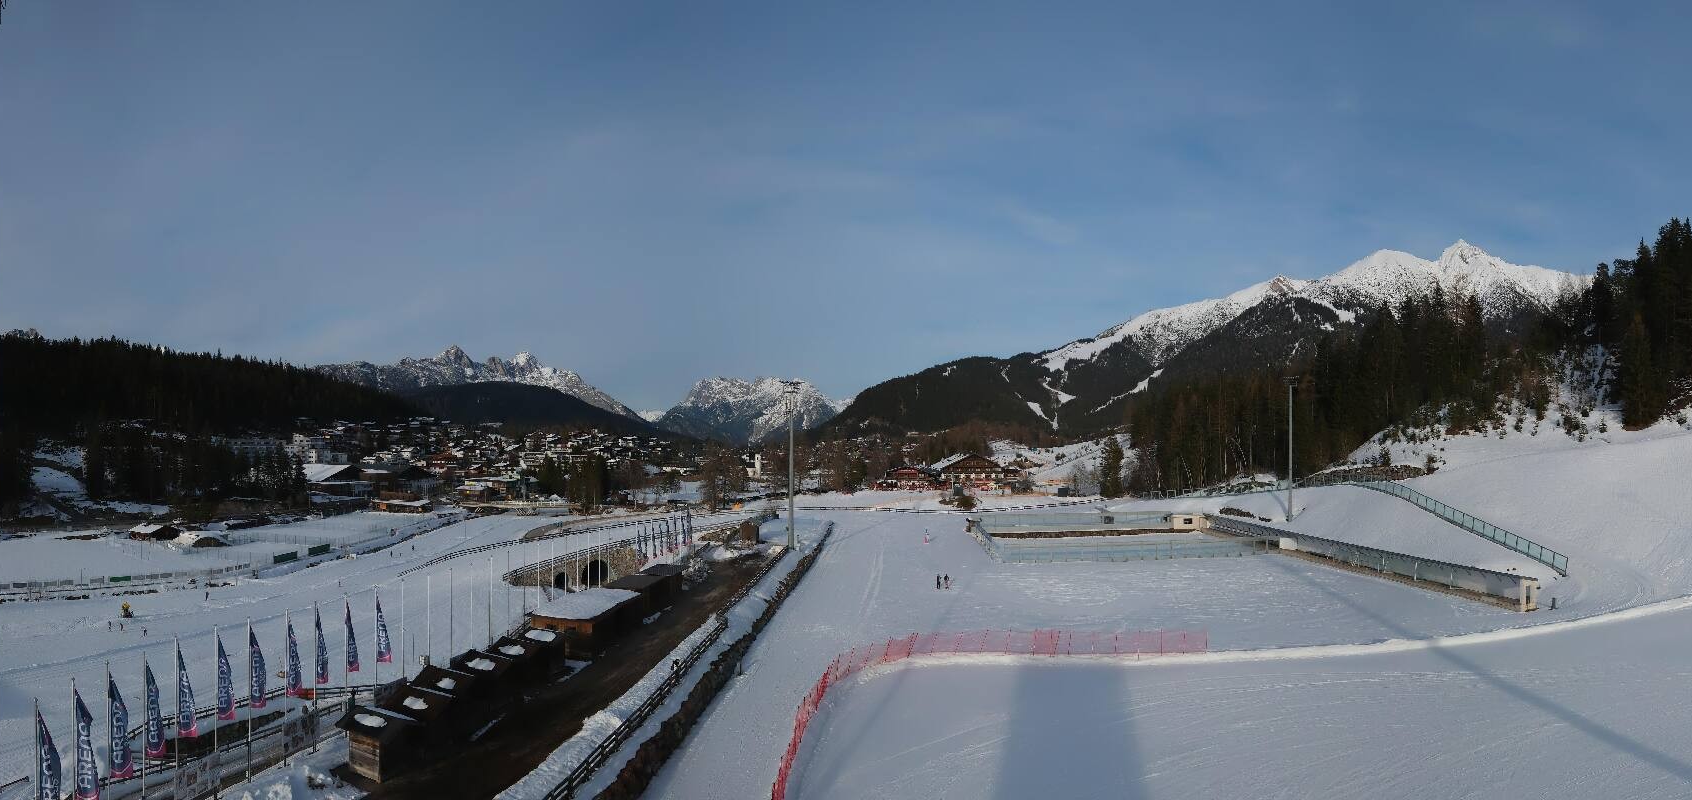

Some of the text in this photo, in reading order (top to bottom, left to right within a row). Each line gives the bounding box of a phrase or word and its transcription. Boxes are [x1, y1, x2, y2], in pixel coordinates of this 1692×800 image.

[180, 671, 190, 722] ARENA
[219, 658, 228, 708] ARENA
[112, 702, 124, 763] ARENA
[148, 685, 159, 742] ARENA
[78, 722, 92, 788] ARENA
